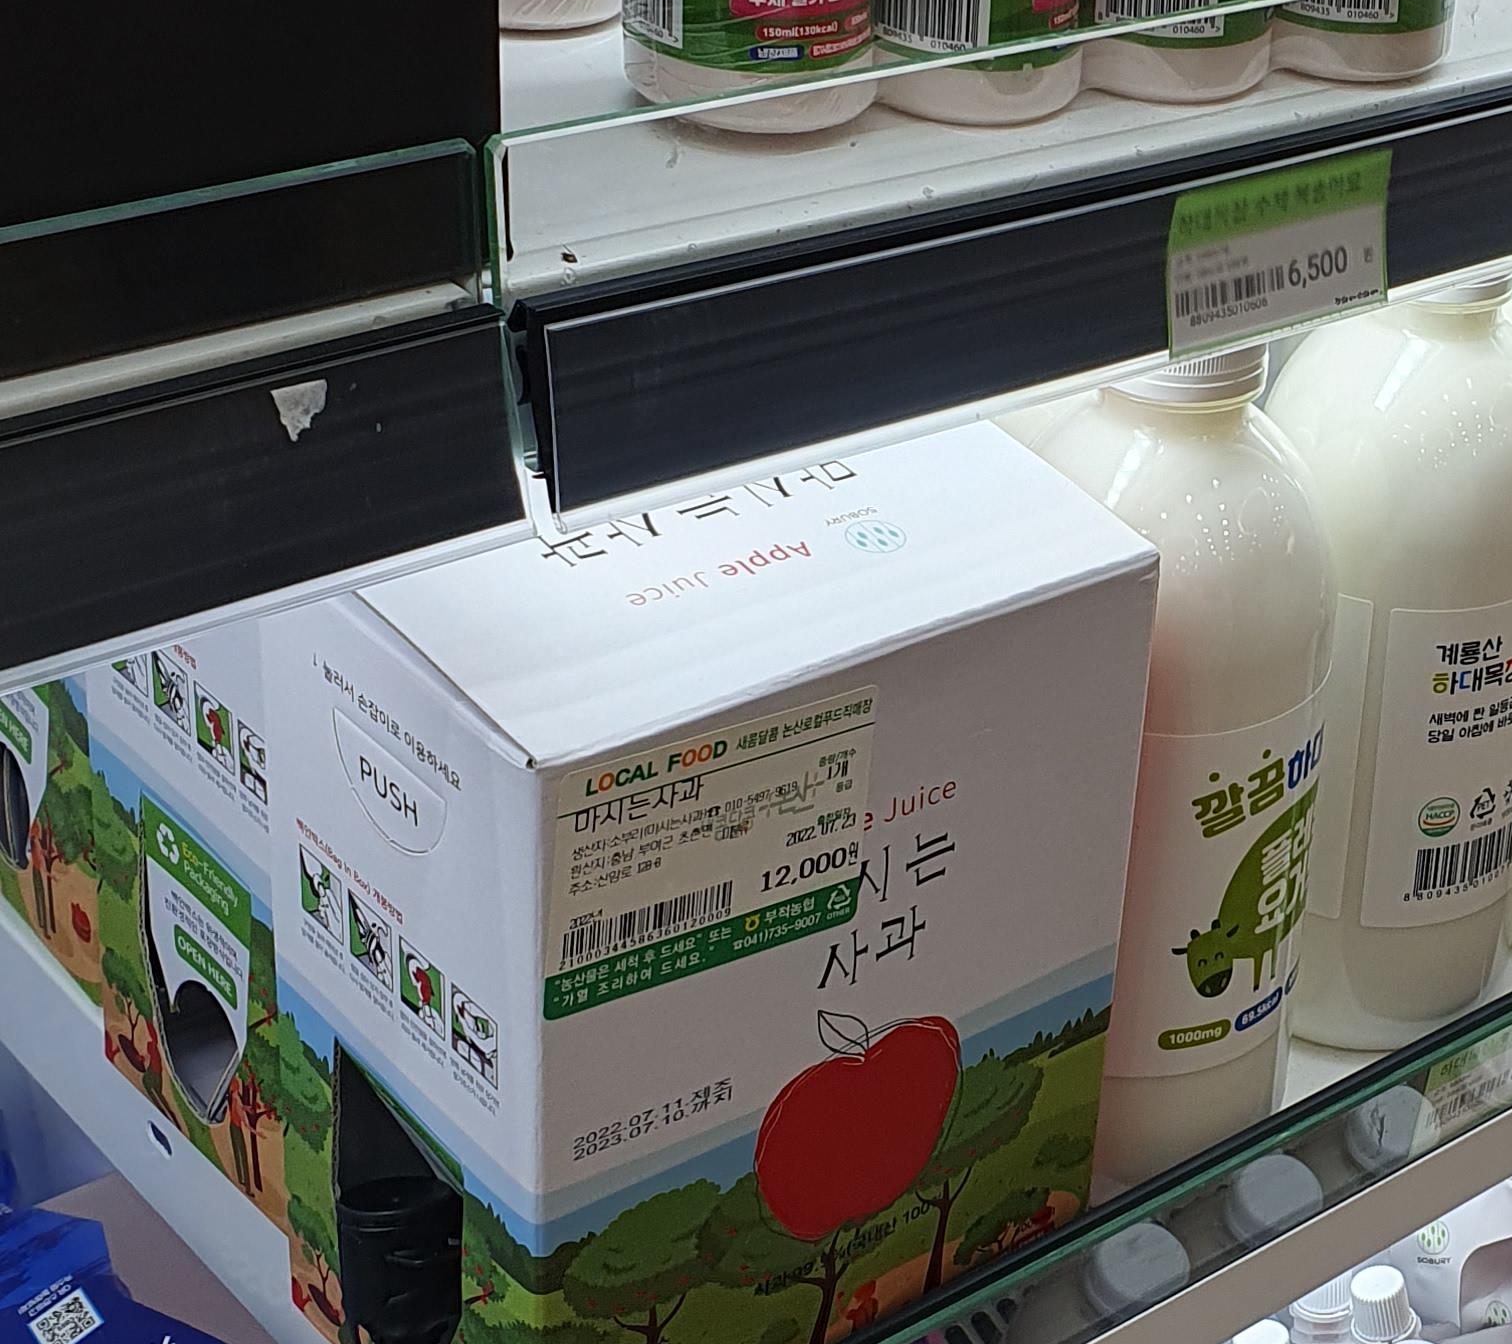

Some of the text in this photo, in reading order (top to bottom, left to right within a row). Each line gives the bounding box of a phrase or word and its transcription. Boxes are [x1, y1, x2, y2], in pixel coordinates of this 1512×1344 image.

[1288, 247, 1348, 288] 6,500
[825, 505, 878, 526] SOBURY
[627, 539, 813, 607] Apple Juice
[1435, 636, 1503, 666] 계룡산
[1428, 727, 1455, 744] 당일
[1459, 720, 1494, 740] 아침에
[1429, 710, 1469, 726] 새벽에
[357, 693, 462, 791] 손잡이로 이용하세요
[585, 726, 778, 797] LOCAL FOOD 새콤달콤
[359, 755, 419, 827] PUSH
[574, 777, 704, 833] 마시는사과
[884, 777, 958, 821] Juice
[1425, 811, 1456, 822] HACCP
[181, 841, 239, 908] Eco-Friendly
[760, 842, 860, 892] 12,000원
[183, 862, 229, 917] Packaging
[764, 897, 815, 924] 부적농협
[708, 926, 732, 944] 또는
[818, 906, 928, 990] 사과
[176, 933, 234, 999] OPEN HERE
[597, 969, 652, 996] 조리하여
[1168, 1024, 1222, 1045] 1000mg
